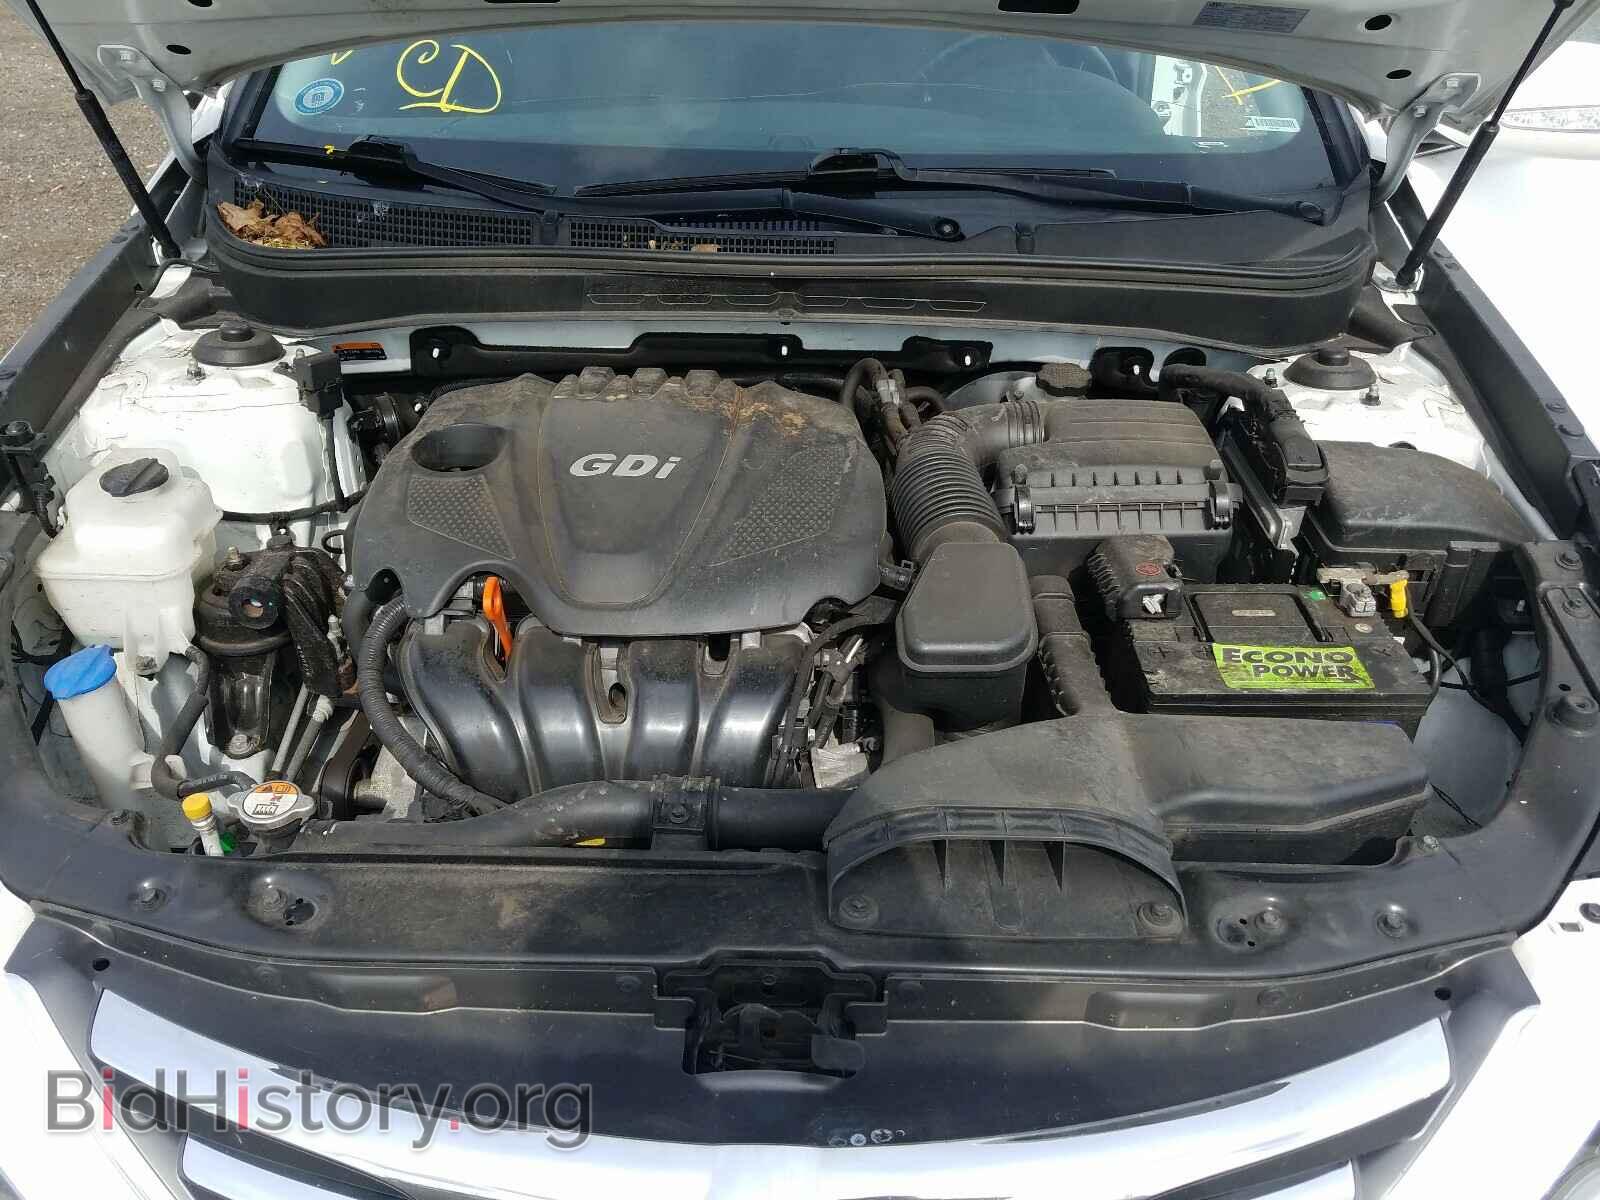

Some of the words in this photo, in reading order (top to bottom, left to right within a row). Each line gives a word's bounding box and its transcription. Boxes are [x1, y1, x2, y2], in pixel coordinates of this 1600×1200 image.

[569, 453, 681, 479] GDi
[1222, 647, 1354, 664] ECONO
[1252, 664, 1360, 683] POWER
